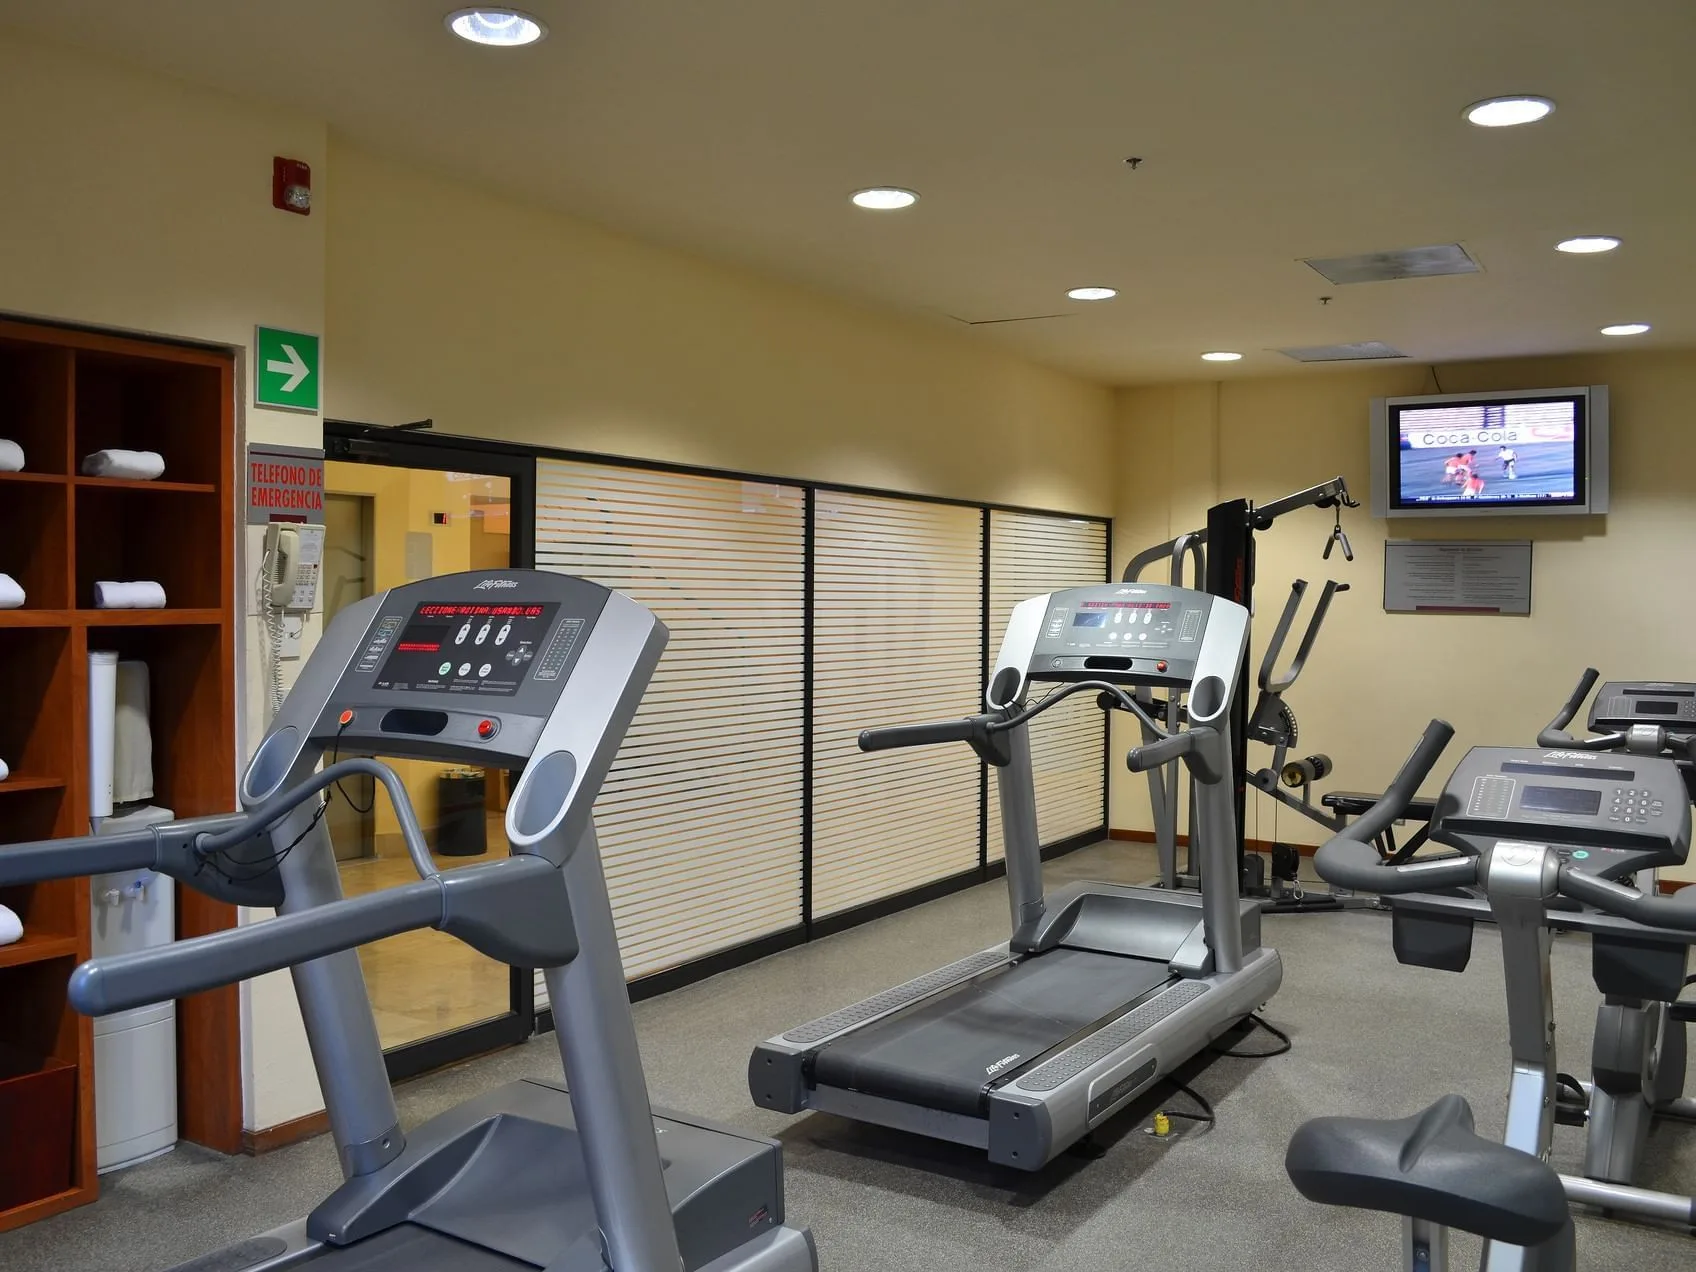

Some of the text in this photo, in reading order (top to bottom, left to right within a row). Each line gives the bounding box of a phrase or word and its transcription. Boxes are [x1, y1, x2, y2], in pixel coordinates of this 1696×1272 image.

[251, 462, 322, 487] TELEFONO DE
[251, 487, 322, 510] EMERGENCIA
